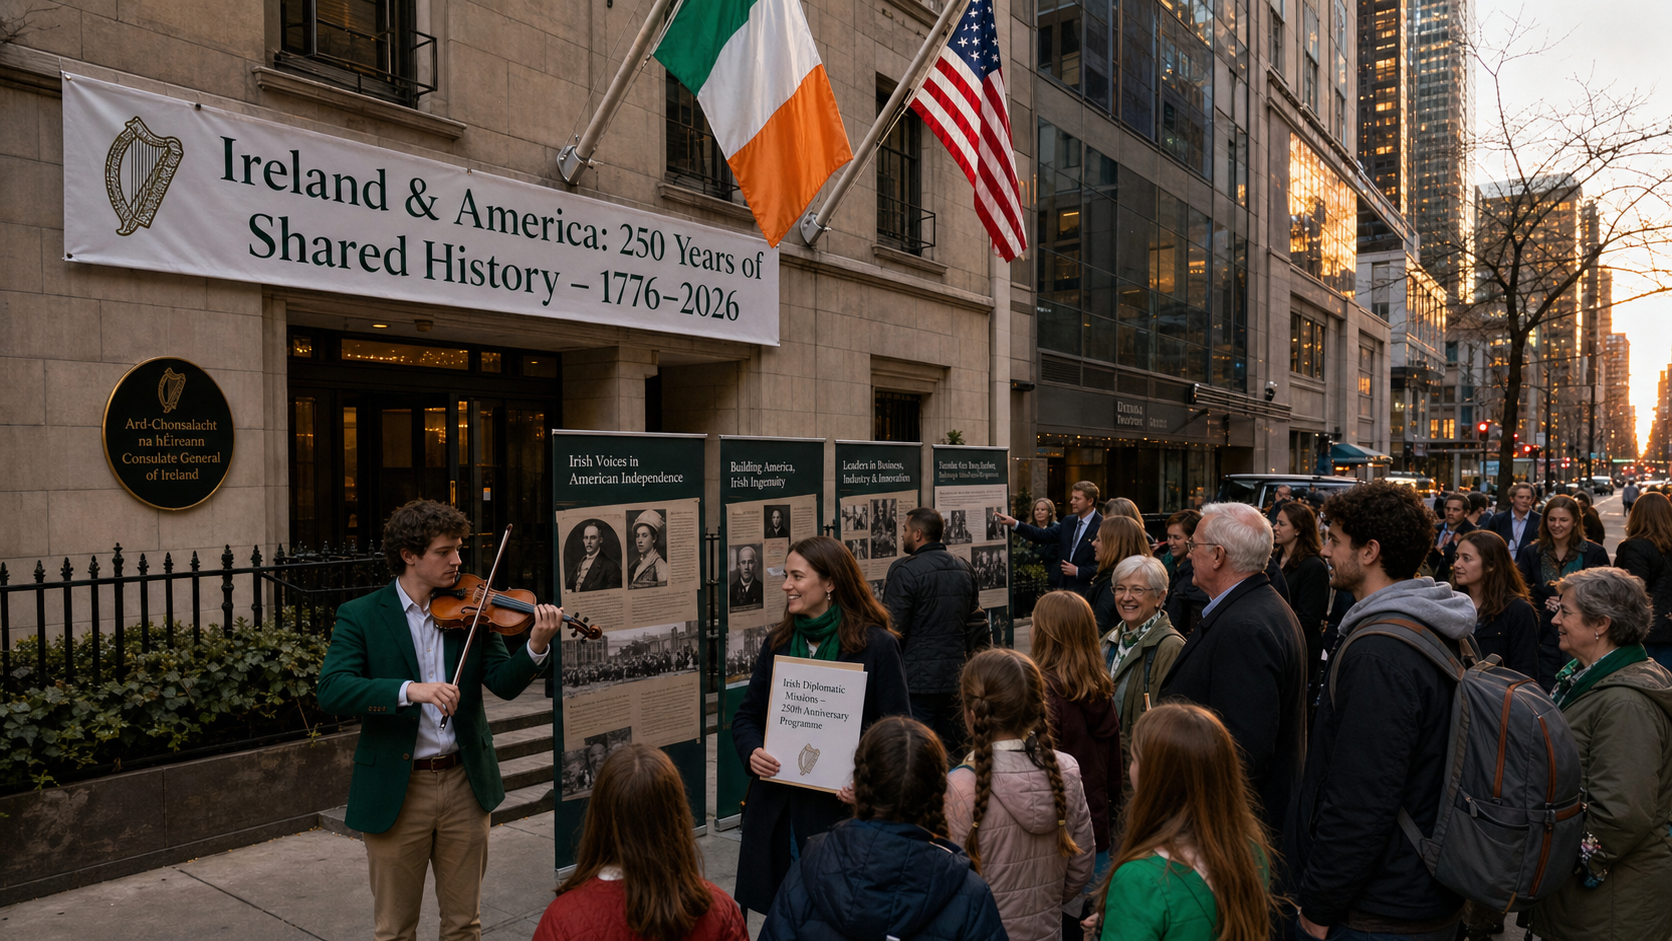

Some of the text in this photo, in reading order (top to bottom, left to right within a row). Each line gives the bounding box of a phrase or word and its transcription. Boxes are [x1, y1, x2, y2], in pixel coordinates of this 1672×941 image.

[220, 136, 764, 280] Ireland & America: 250 Years of
[249, 213, 410, 277] Shared
[423, 240, 561, 307] History
[600, 269, 740, 322] 1776–2026
[125, 418, 217, 431] Ard-Chonsalacht
[138, 433, 205, 447] na hÉireann
[122, 452, 221, 464] Consulate General
[569, 454, 639, 467] Irish Voices in
[870, 460, 876, 470] in
[145, 468, 199, 481] of Ireland
[730, 460, 796, 475] Building America,
[569, 471, 683, 487] American Independence
[730, 475, 786, 490] Irish Ingenuity
[843, 473, 870, 486] Industry
[871, 473, 878, 483] &
[783, 678, 846, 694] Irish Diplomatic
[785, 691, 819, 704] Missions
[781, 704, 850, 722] 250th Anniversary
[780, 716, 823, 730] Programme
